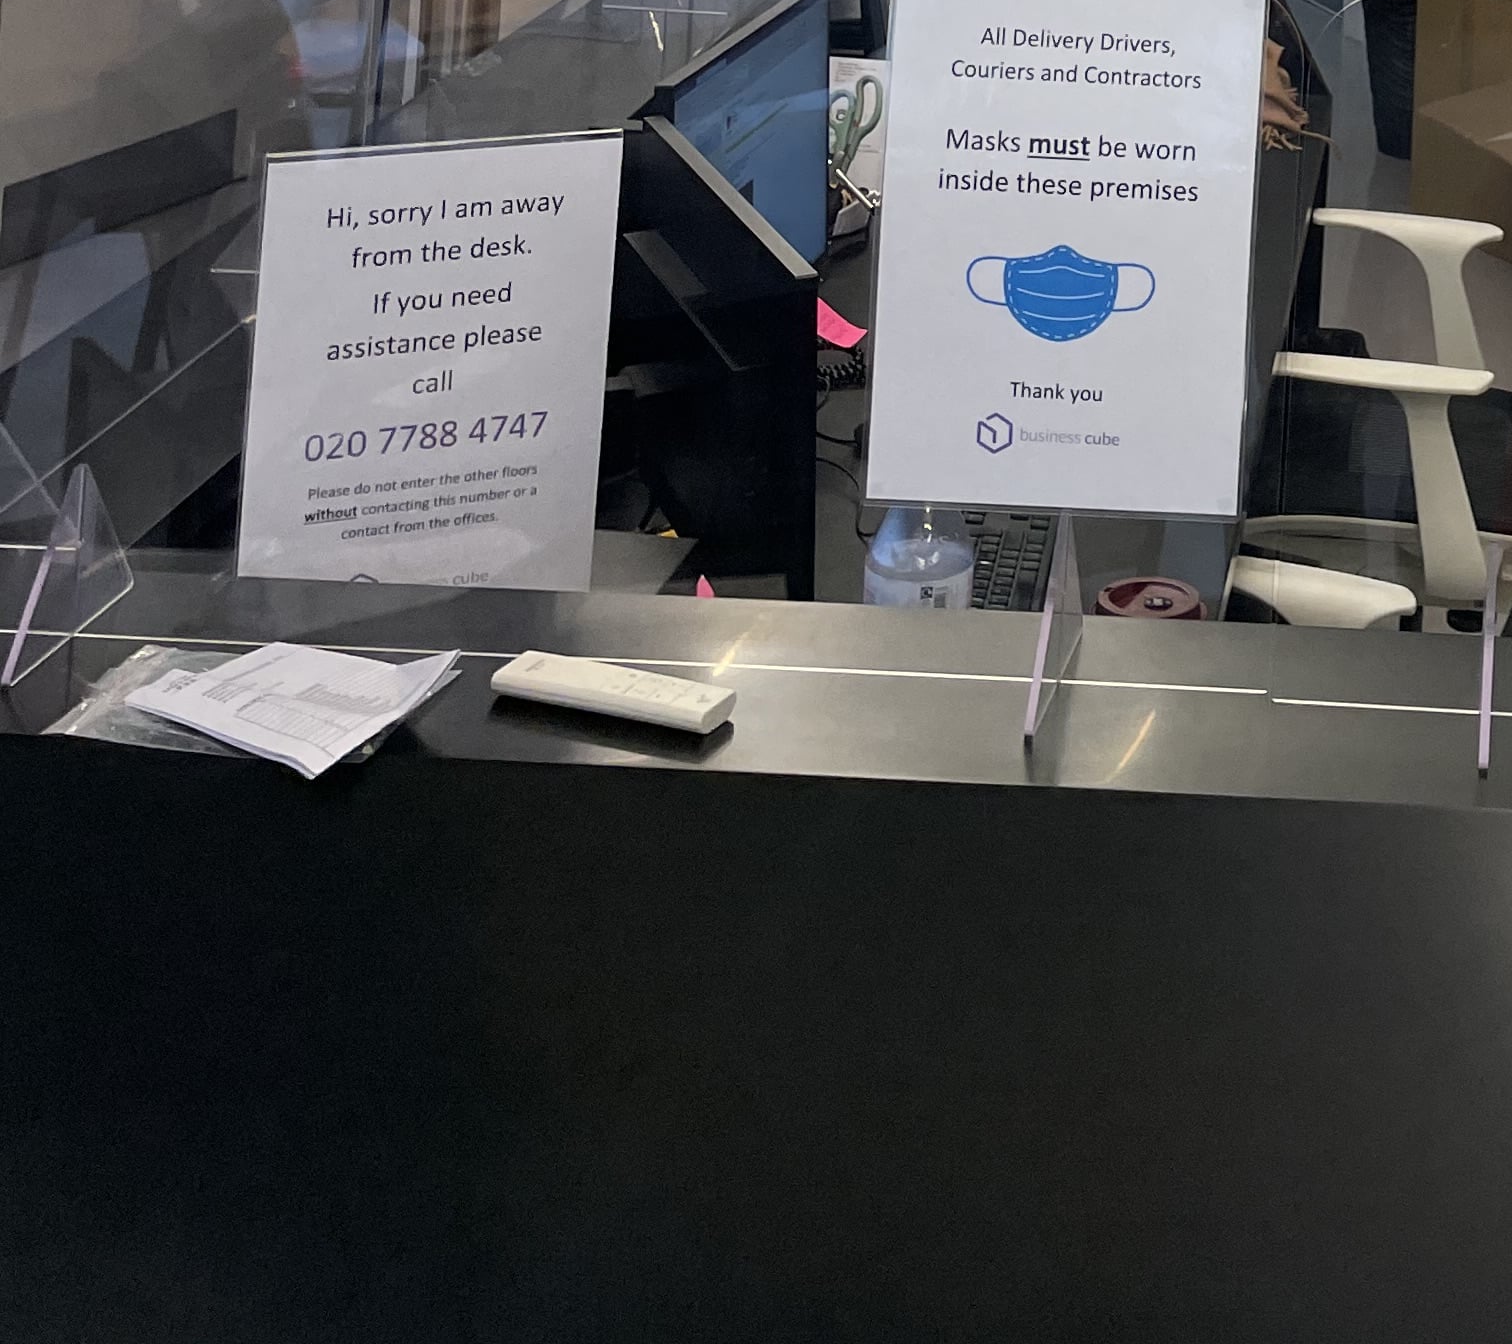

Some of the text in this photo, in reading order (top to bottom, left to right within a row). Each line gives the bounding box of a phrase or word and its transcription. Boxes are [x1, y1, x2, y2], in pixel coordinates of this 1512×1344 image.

[980, 27, 1175, 58] All Delivery Drivers,
[951, 59, 1201, 89] Couriers and Contractors
[946, 128, 1196, 162] Masks must be worn
[938, 168, 1198, 202] inside these premises
[327, 195, 565, 231] Hi, sorry I am away
[351, 233, 532, 269] from the desk.
[373, 281, 512, 317] If you need
[326, 324, 542, 361] assistance please
[412, 369, 453, 395] call
[1010, 381, 1103, 405] Thank you
[304, 410, 549, 462] 020 7788 4747
[1019, 426, 1120, 447] business cube
[307, 465, 538, 501] Please do not enter the other floors
[303, 486, 538, 526] without contacting this number or a
[340, 523, 391, 540] contact
[393, 520, 425, 534] from
[428, 516, 451, 530] the
[451, 570, 489, 586] cube
